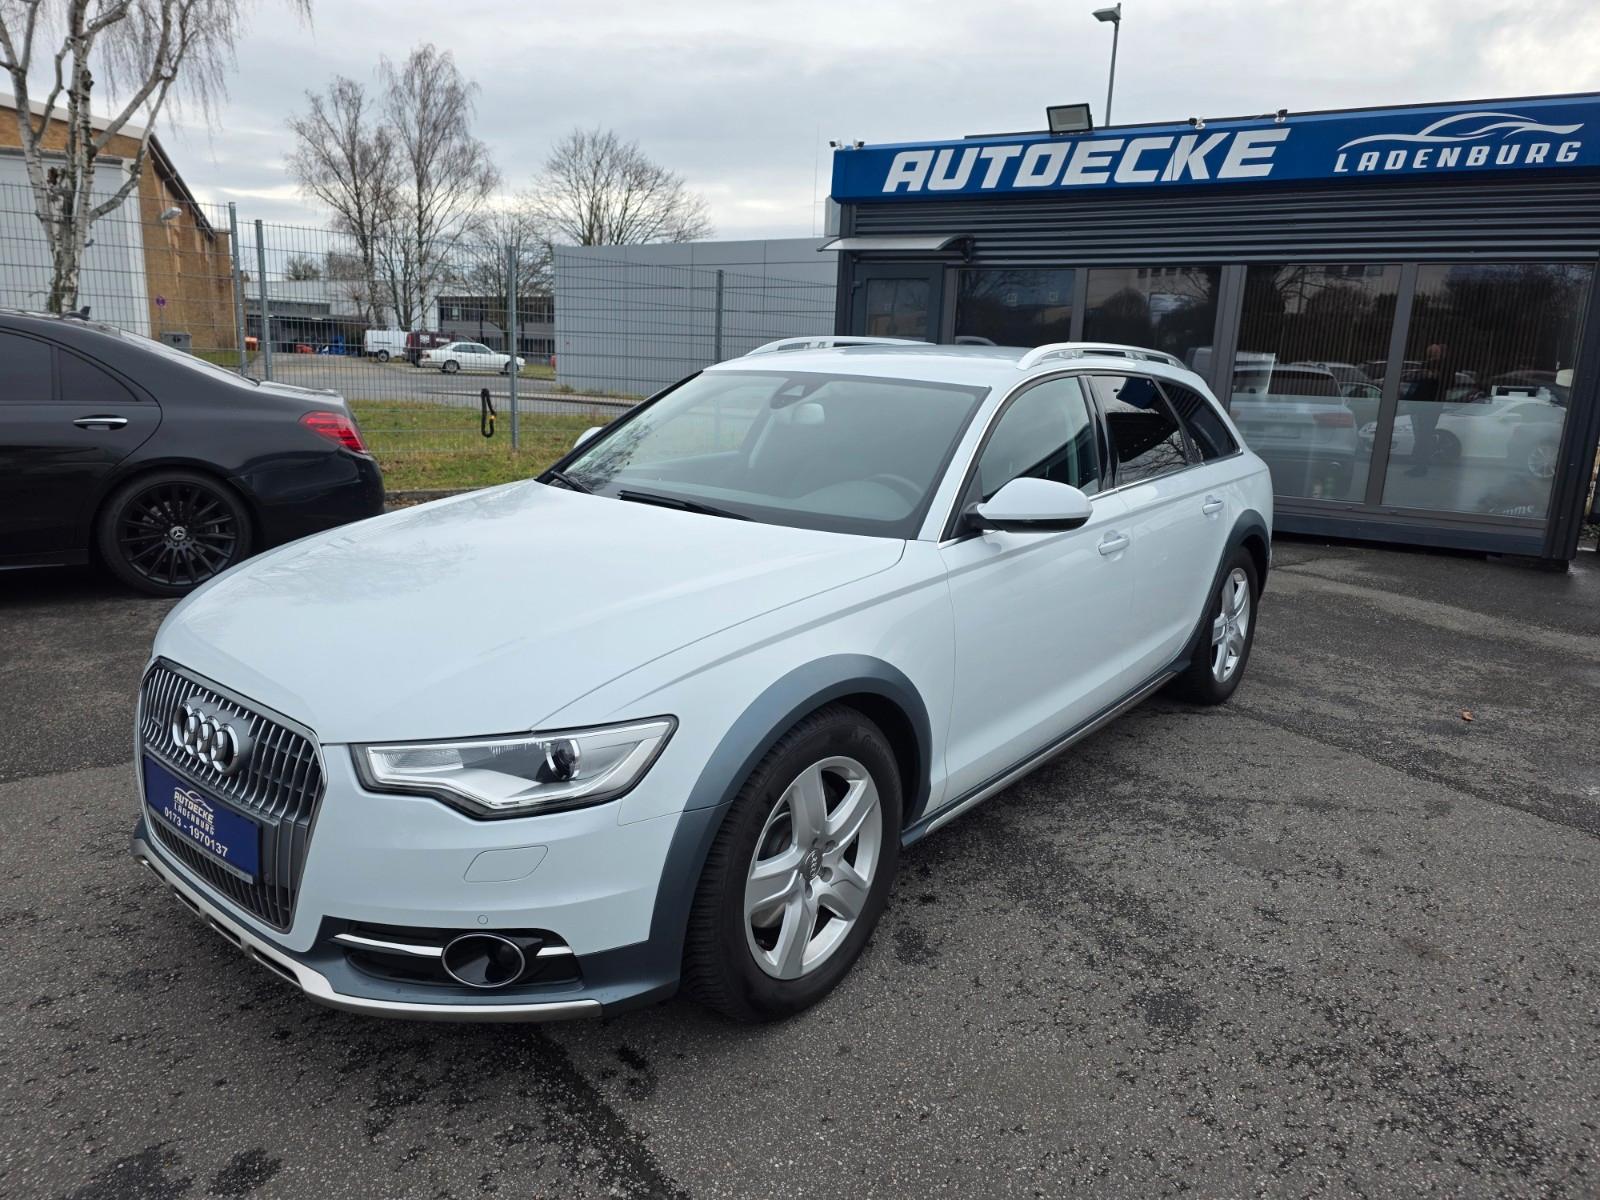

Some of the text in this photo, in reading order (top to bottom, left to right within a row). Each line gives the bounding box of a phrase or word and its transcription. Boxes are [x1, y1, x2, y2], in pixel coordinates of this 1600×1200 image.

[881, 128, 1292, 193] AUTOECKE
[1333, 141, 1583, 173] LADENBURG
[174, 791, 214, 824] AUTOECKE
[174, 802, 215, 835] LADENBURG
[164, 806, 181, 827] 0173
[189, 825, 228, 857] 1970137
